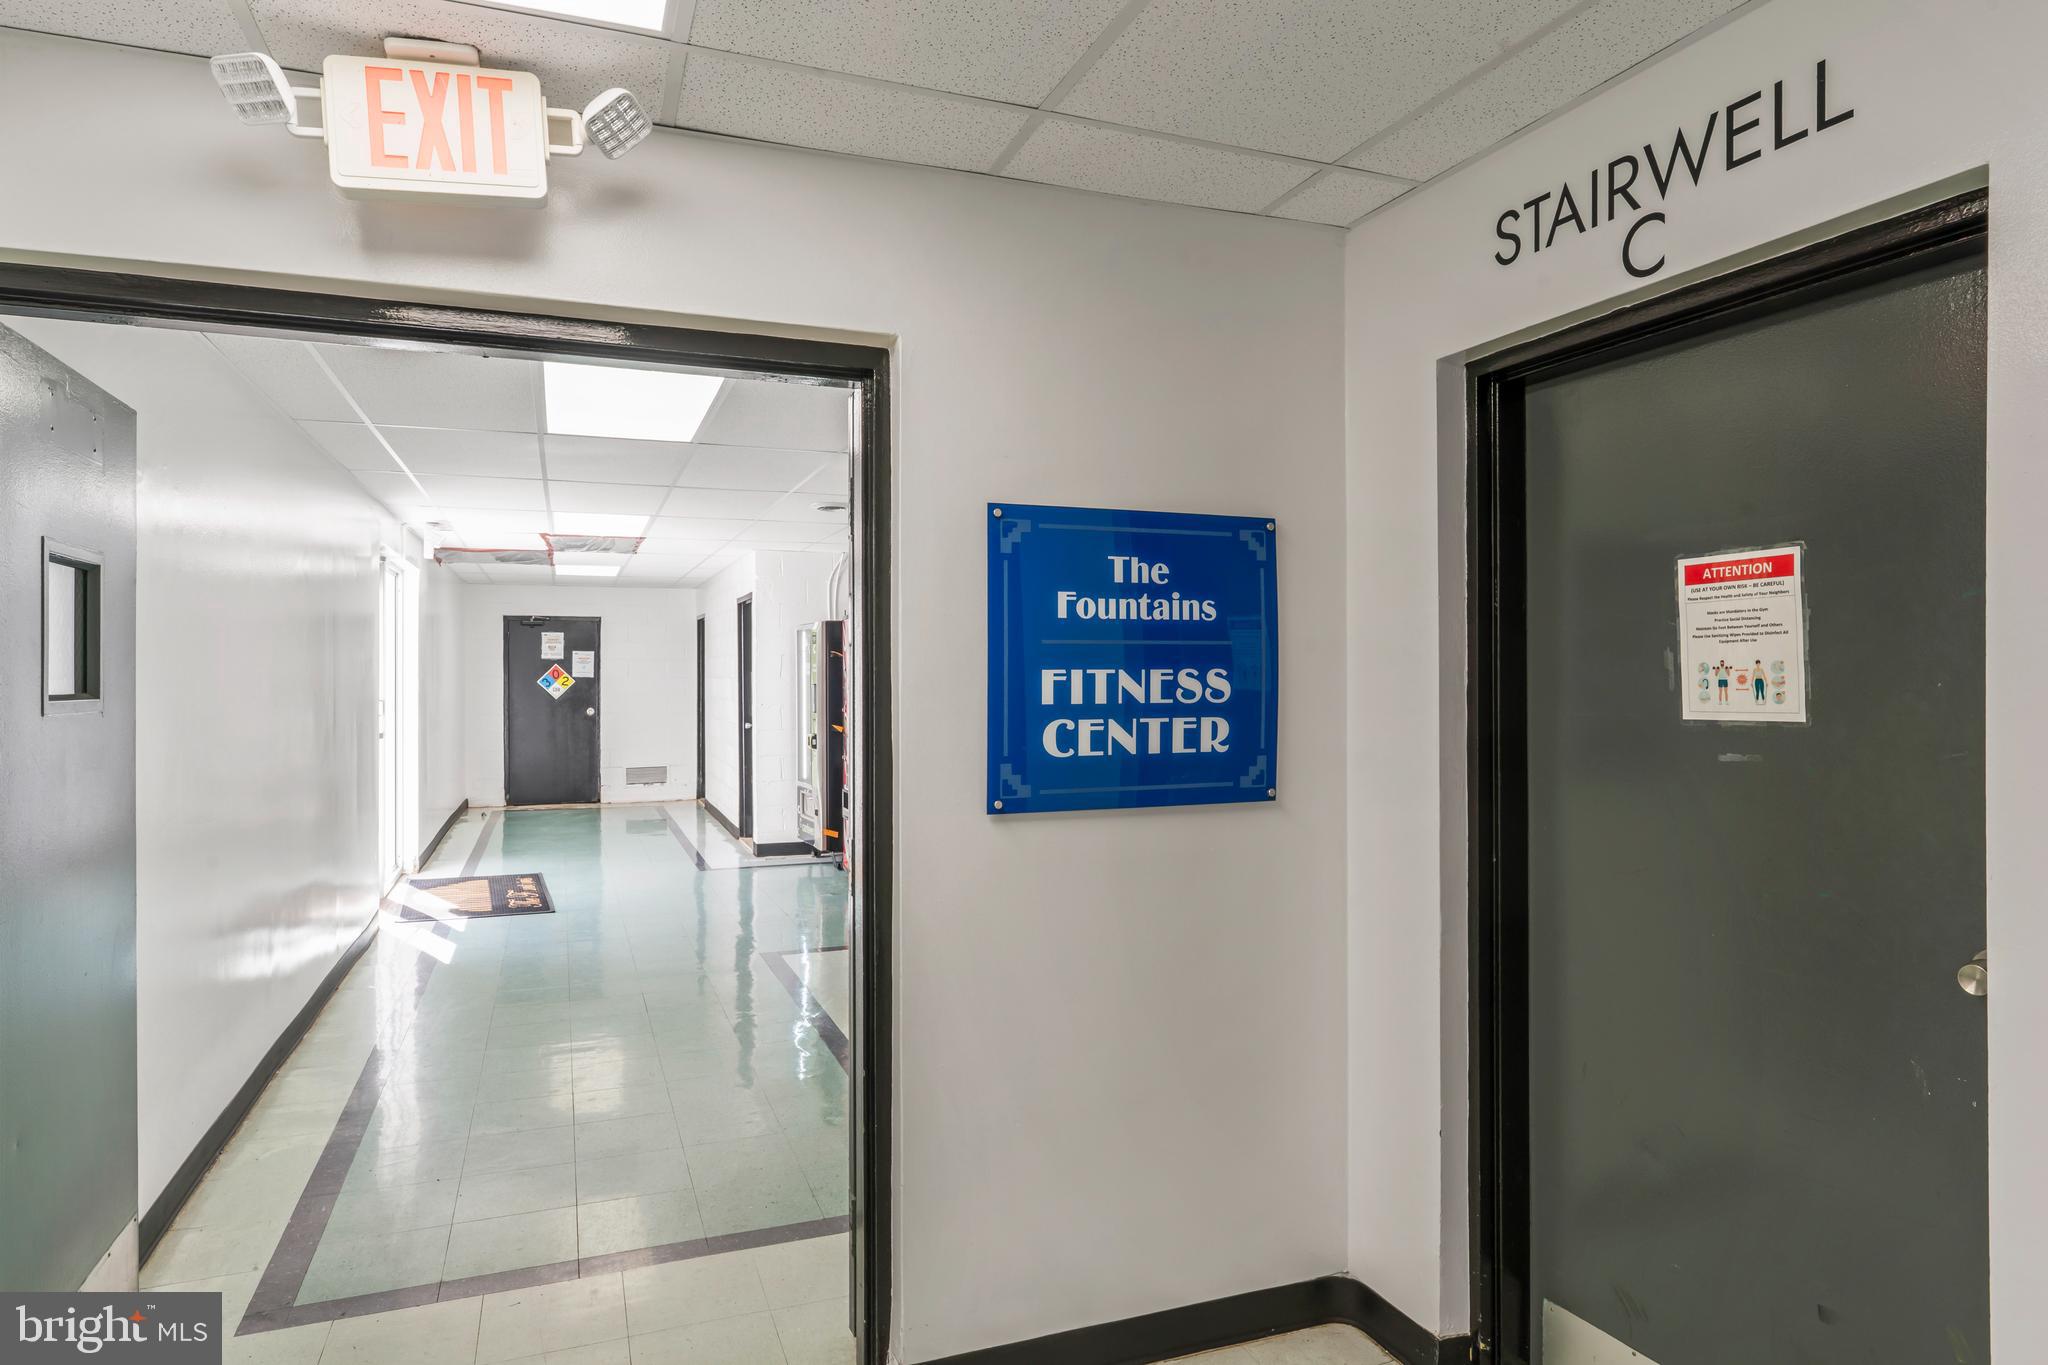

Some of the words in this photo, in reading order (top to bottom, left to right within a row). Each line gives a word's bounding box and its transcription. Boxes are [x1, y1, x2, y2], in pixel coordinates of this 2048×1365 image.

[364, 66, 513, 175] EXIT
[1494, 59, 1855, 266] STAIRWELL
[1622, 212, 1666, 278] C
[1107, 555, 1170, 585] The
[1702, 562, 1773, 580] ATTENTION
[1057, 590, 1217, 622] Fountains
[541, 678, 551, 688] 3
[561, 676, 569, 687] 2
[552, 669, 560, 680] 0
[1041, 667, 1232, 705] FITNESS
[1042, 716, 1230, 758] CENTER
